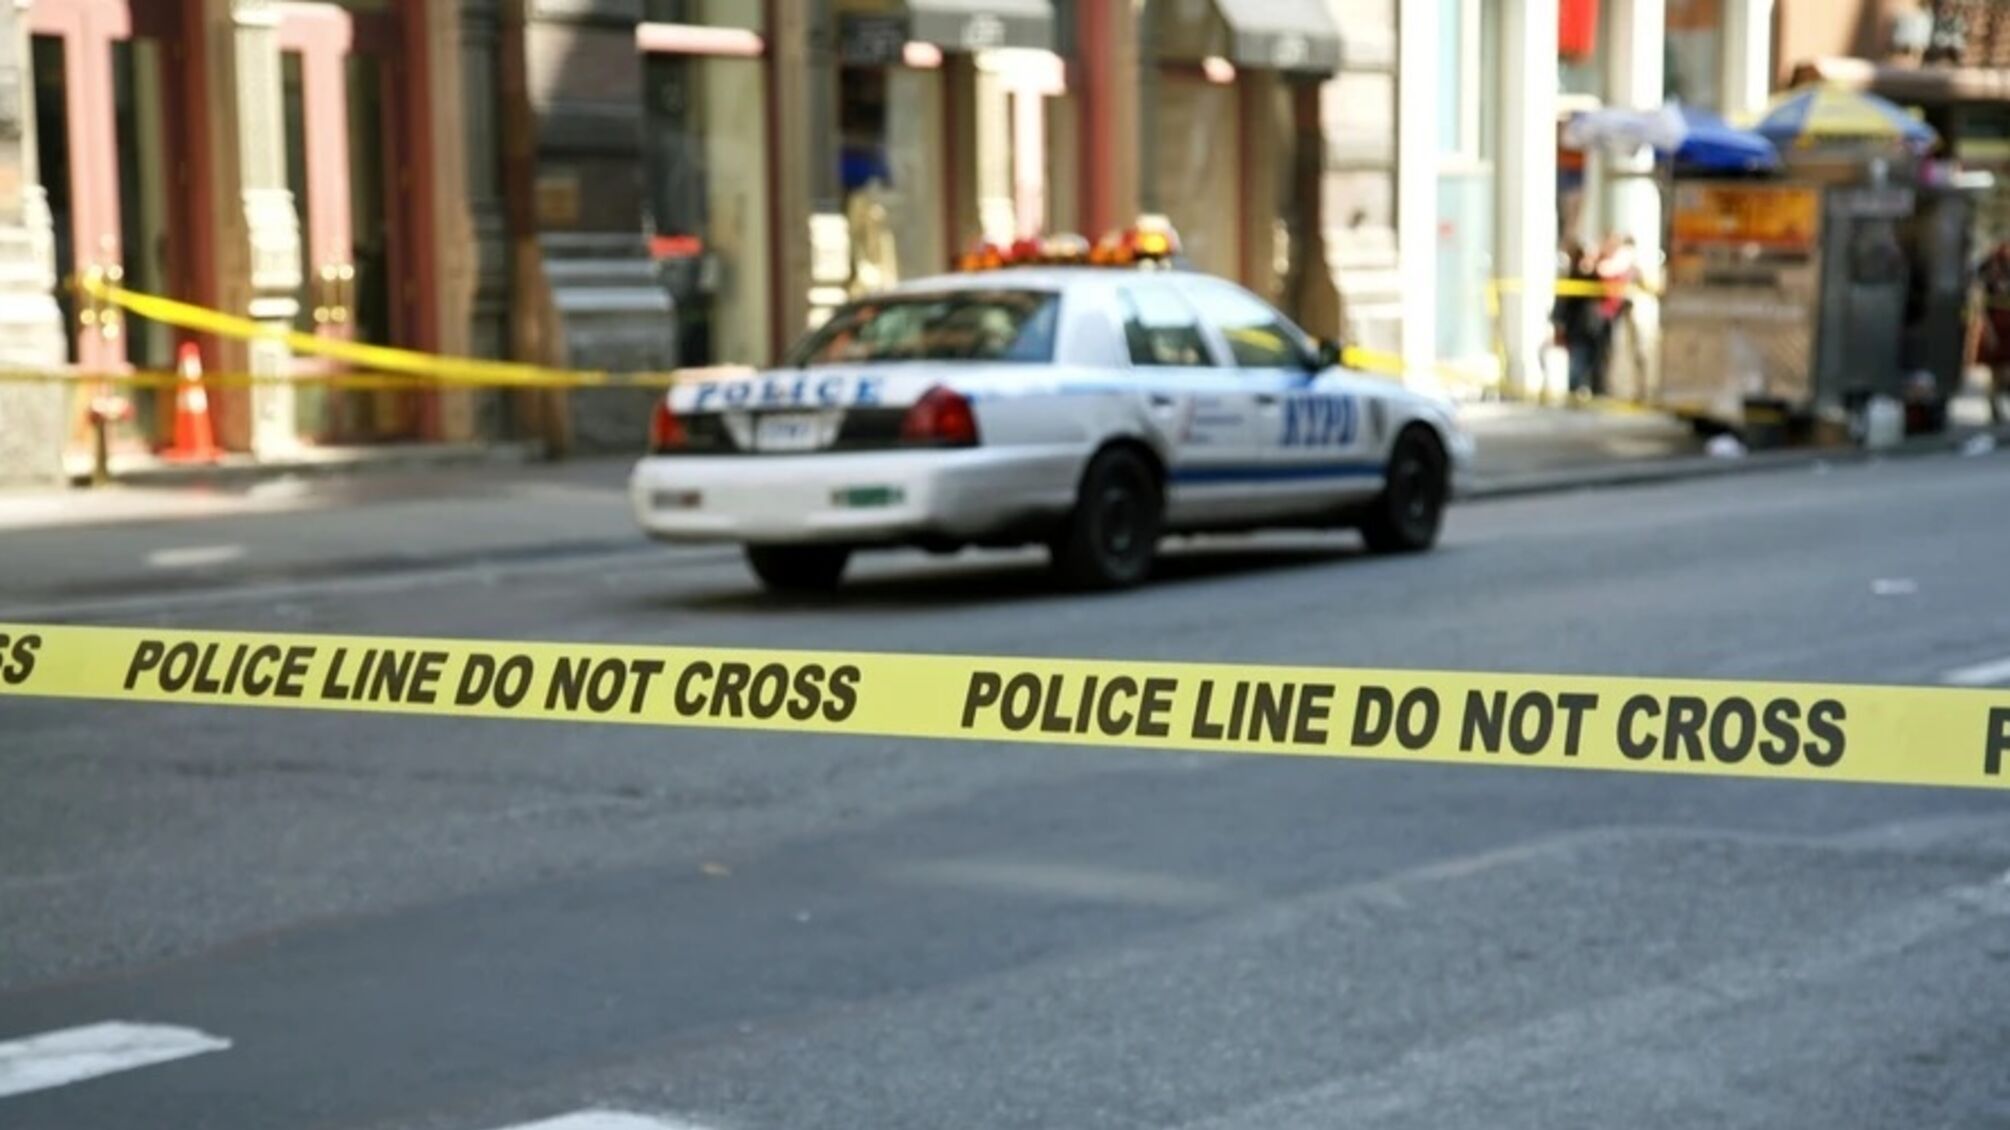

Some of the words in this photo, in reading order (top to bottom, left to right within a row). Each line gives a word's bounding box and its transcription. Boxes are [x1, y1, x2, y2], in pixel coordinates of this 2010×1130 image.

[693, 375, 885, 412] POLICE
[1281, 392, 1358, 446] NYPD
[123, 640, 317, 698] POLICE
[320, 647, 450, 705] LINE
[454, 653, 534, 709] DO
[543, 656, 666, 714] NOT
[674, 660, 861, 724] CROSS
[961, 671, 1179, 739] POLICE
[1190, 679, 1336, 745] LINE
[1350, 685, 1441, 751] DO
[1458, 689, 1600, 757] NOT
[1616, 693, 1847, 768] CROSS
